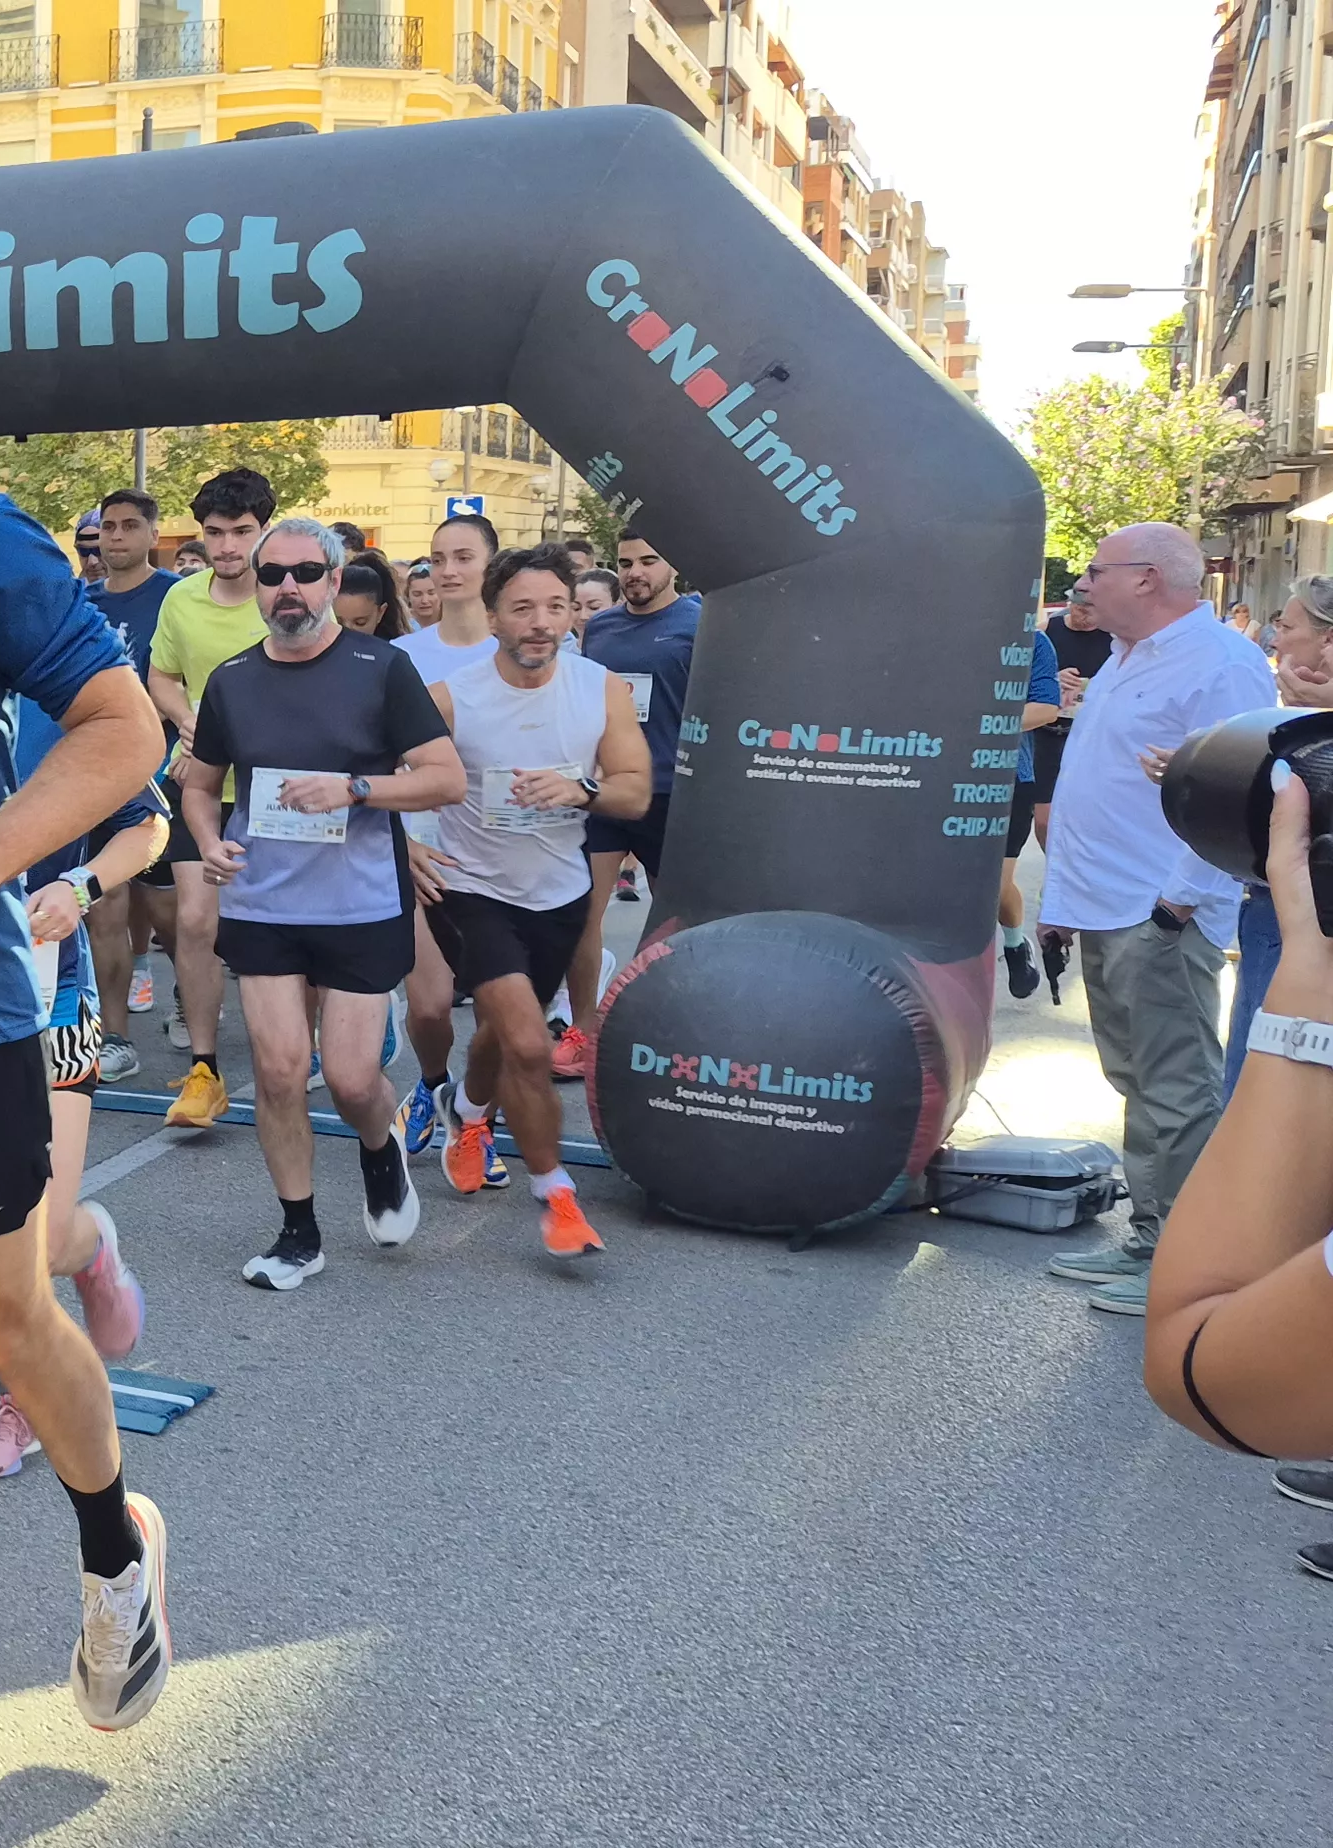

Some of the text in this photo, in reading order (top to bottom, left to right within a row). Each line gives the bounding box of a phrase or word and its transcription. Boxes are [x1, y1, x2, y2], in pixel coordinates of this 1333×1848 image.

[753, 753, 797, 767] Servicio
[797, 757, 815, 769] de
[787, 770, 805, 782] de
[805, 773, 855, 786] eventos
[855, 774, 922, 789] deportivos
[942, 815, 988, 837] CHIP
[674, 1085, 726, 1106] Servicio
[728, 1093, 747, 1109] de
[804, 1106, 818, 1118] y
[685, 1102, 773, 1127] promocional
[774, 1114, 845, 1135] deportivo
